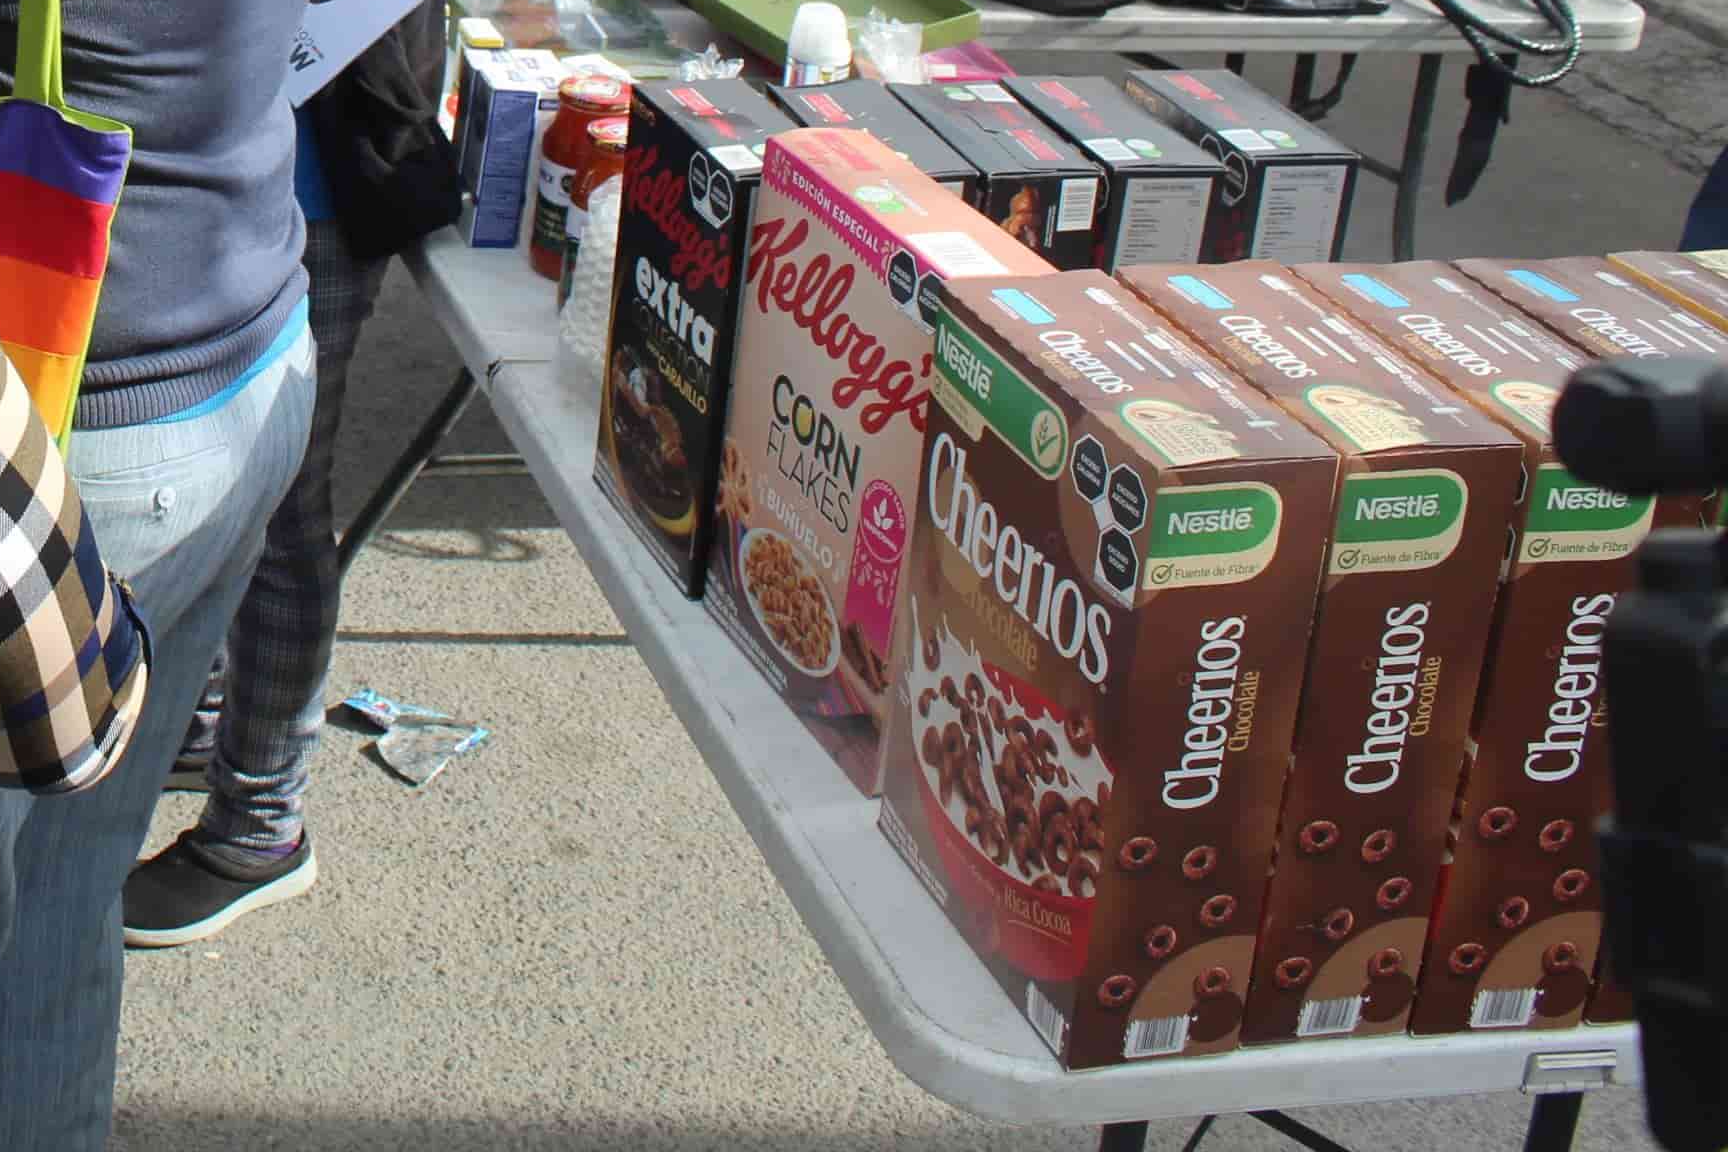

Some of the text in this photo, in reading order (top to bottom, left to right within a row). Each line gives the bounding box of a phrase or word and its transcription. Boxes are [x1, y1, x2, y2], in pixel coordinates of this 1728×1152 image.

[624, 145, 733, 290] Kellogg's
[791, 167, 882, 254] EDICIÓN ESPECIAL
[635, 255, 716, 364] extra
[746, 217, 933, 435] Kellogg's
[1218, 314, 1317, 379] Cheerios
[1398, 313, 1500, 377] Cheerios
[656, 354, 709, 416] CARAJILLO
[1038, 330, 1134, 395] Cheerios
[771, 374, 862, 492] CORN
[766, 420, 851, 534] FLAKES
[1355, 493, 1440, 522] Nestlé
[928, 431, 1112, 685] Cheerios
[1167, 506, 1254, 536] Nestlé
[1360, 550, 1440, 566] Fuente de Fibra
[1549, 541, 1629, 555] Fuente de Fibra
[1174, 564, 1254, 580] Fuente de Fibra
[1162, 615, 1246, 810] Cheerios
[1226, 670, 1260, 752] Chocolate
[1344, 601, 1430, 795] Cheerios
[1409, 655, 1442, 737] Chocolate
[1523, 593, 1615, 783] Cheerios
[1004, 887, 1073, 936] Rica Cocoa
